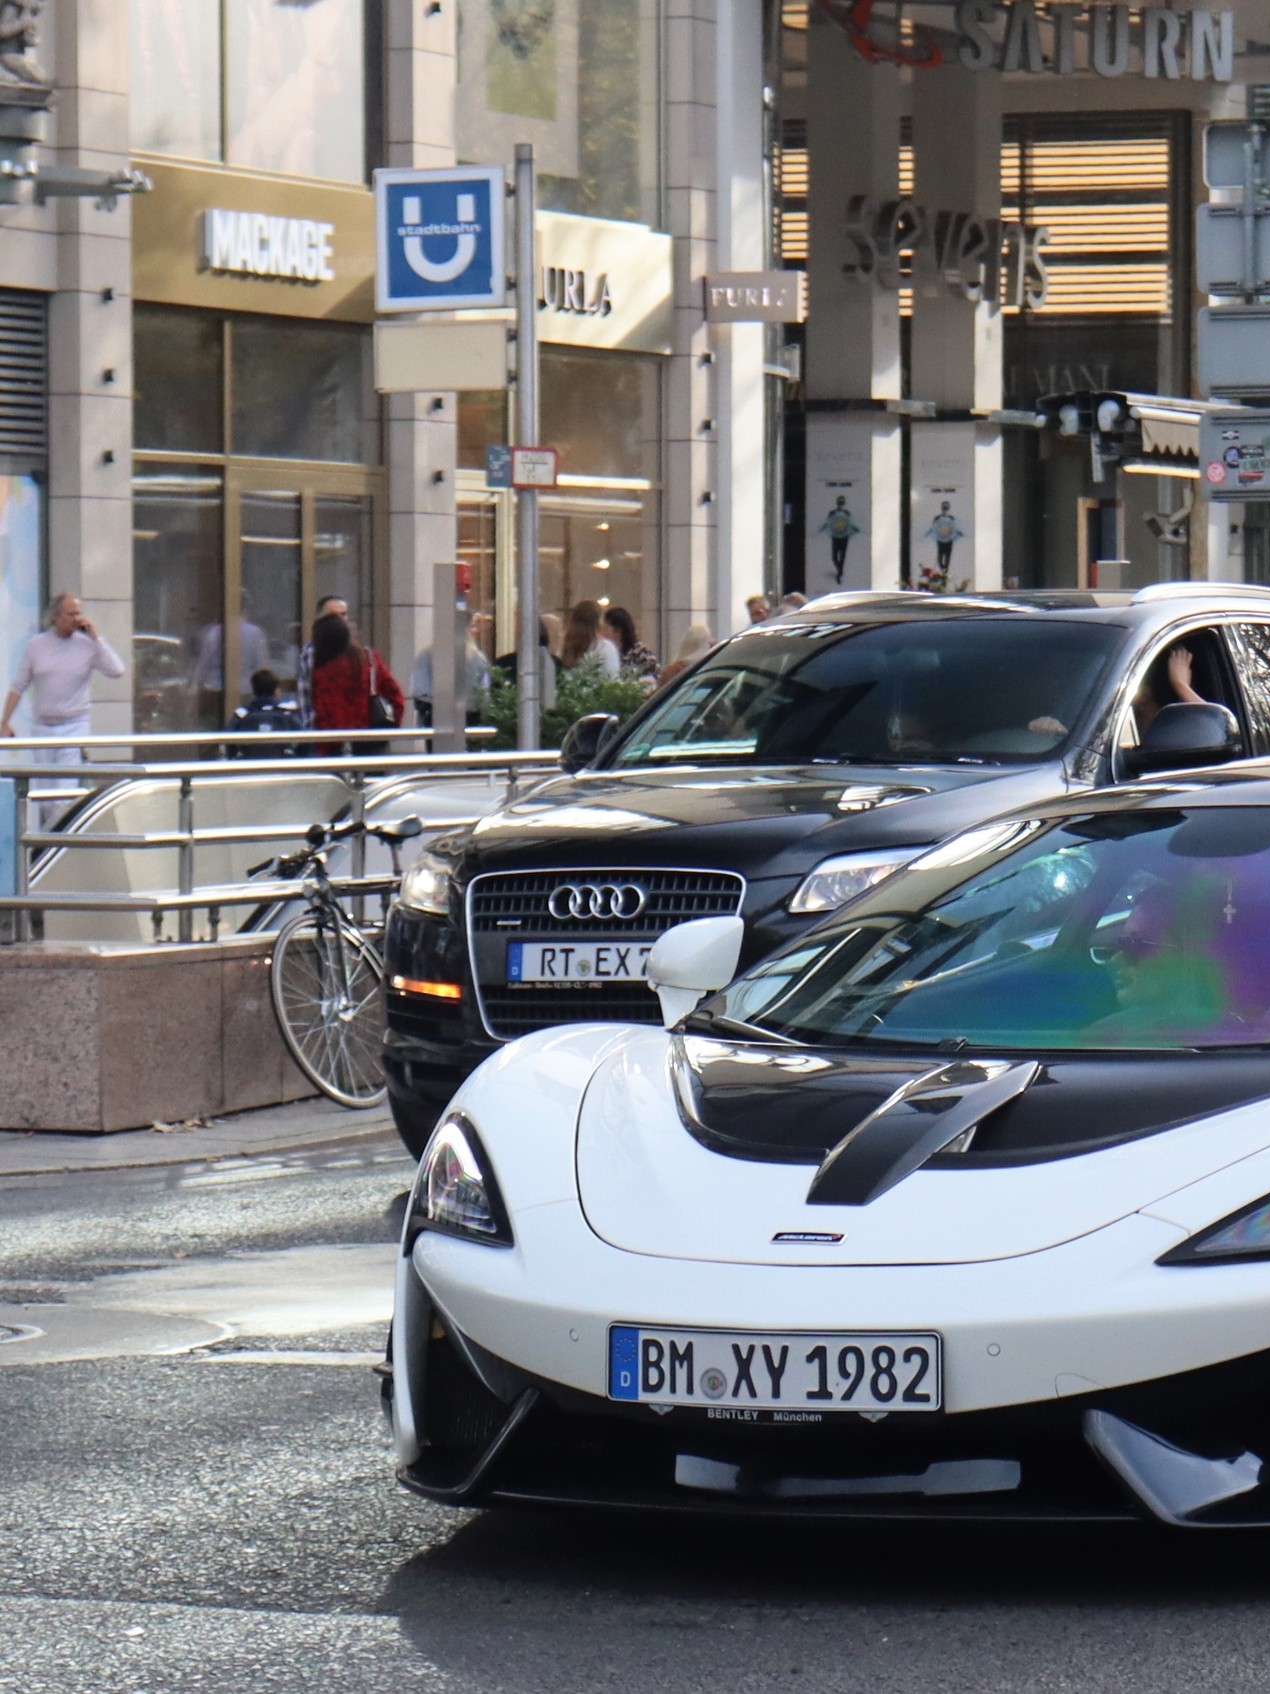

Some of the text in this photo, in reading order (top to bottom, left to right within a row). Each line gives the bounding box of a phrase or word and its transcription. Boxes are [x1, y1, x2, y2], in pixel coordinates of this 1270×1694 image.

[957, 1, 1234, 81] SATURN
[205, 207, 335, 281] MACKAGE
[396, 222, 483, 236] stadtbahn
[537, 266, 612, 317] URLA
[540, 947, 576, 977] RT
[594, 946, 631, 977] EX
[619, 1338, 932, 1404] D BM XY 1982
[707, 1407, 823, 1423] BENTLEY München
